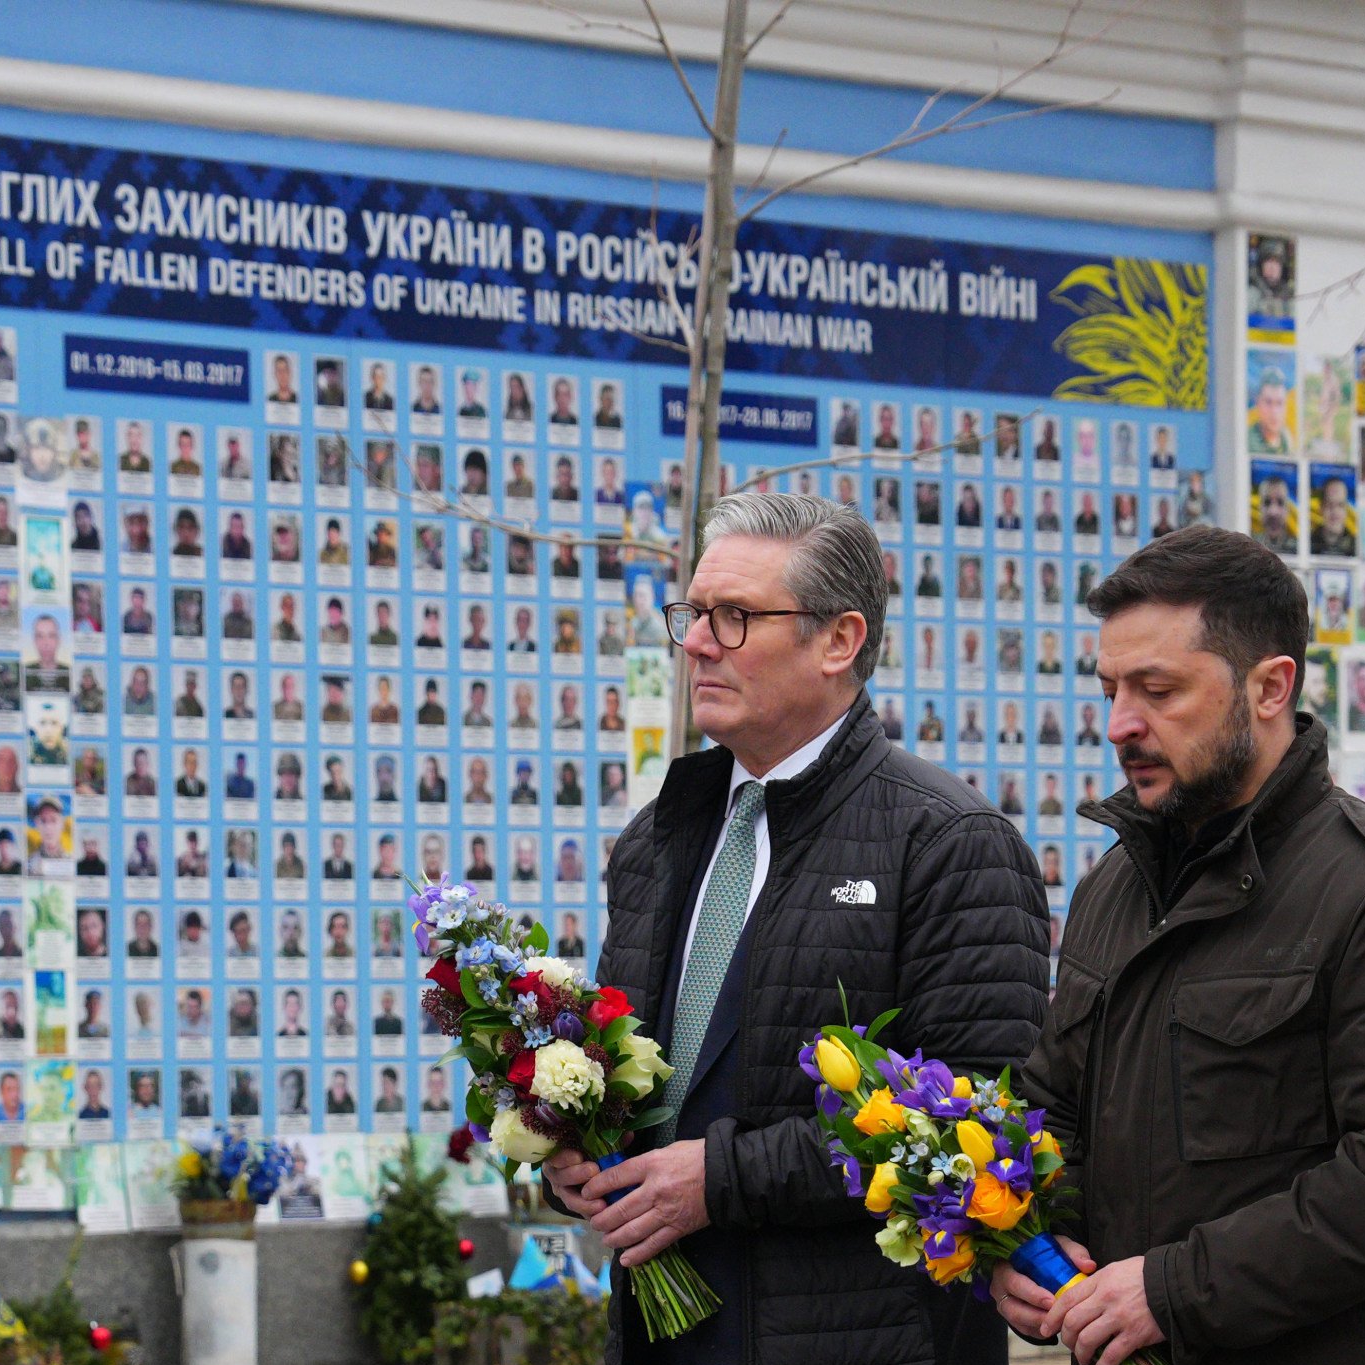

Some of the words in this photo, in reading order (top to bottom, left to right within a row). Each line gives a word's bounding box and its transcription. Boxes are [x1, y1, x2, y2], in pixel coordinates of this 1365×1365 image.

[114, 183, 348, 254] ЗАХИСНИКІВ
[362, 209, 512, 271] УКРАЇНИ
[522, 227, 546, 274] В
[556, 227, 949, 314] РОСІЙСЬО-УКРАЇНСЬКІЙ
[958, 265, 1038, 322] ВІЙНІ
[46, 240, 85, 280] OF
[95, 245, 198, 292] FALLEN
[208, 257, 366, 308] DEFENDERS
[372, 273, 408, 311] OF
[414, 277, 526, 323] UKRAINE
[534, 289, 561, 326] IN
[818, 315, 873, 354] WAR
[846, 880, 863, 890] THE
[830, 887, 860, 898] NORTH
[835, 895, 859, 904] FACE
